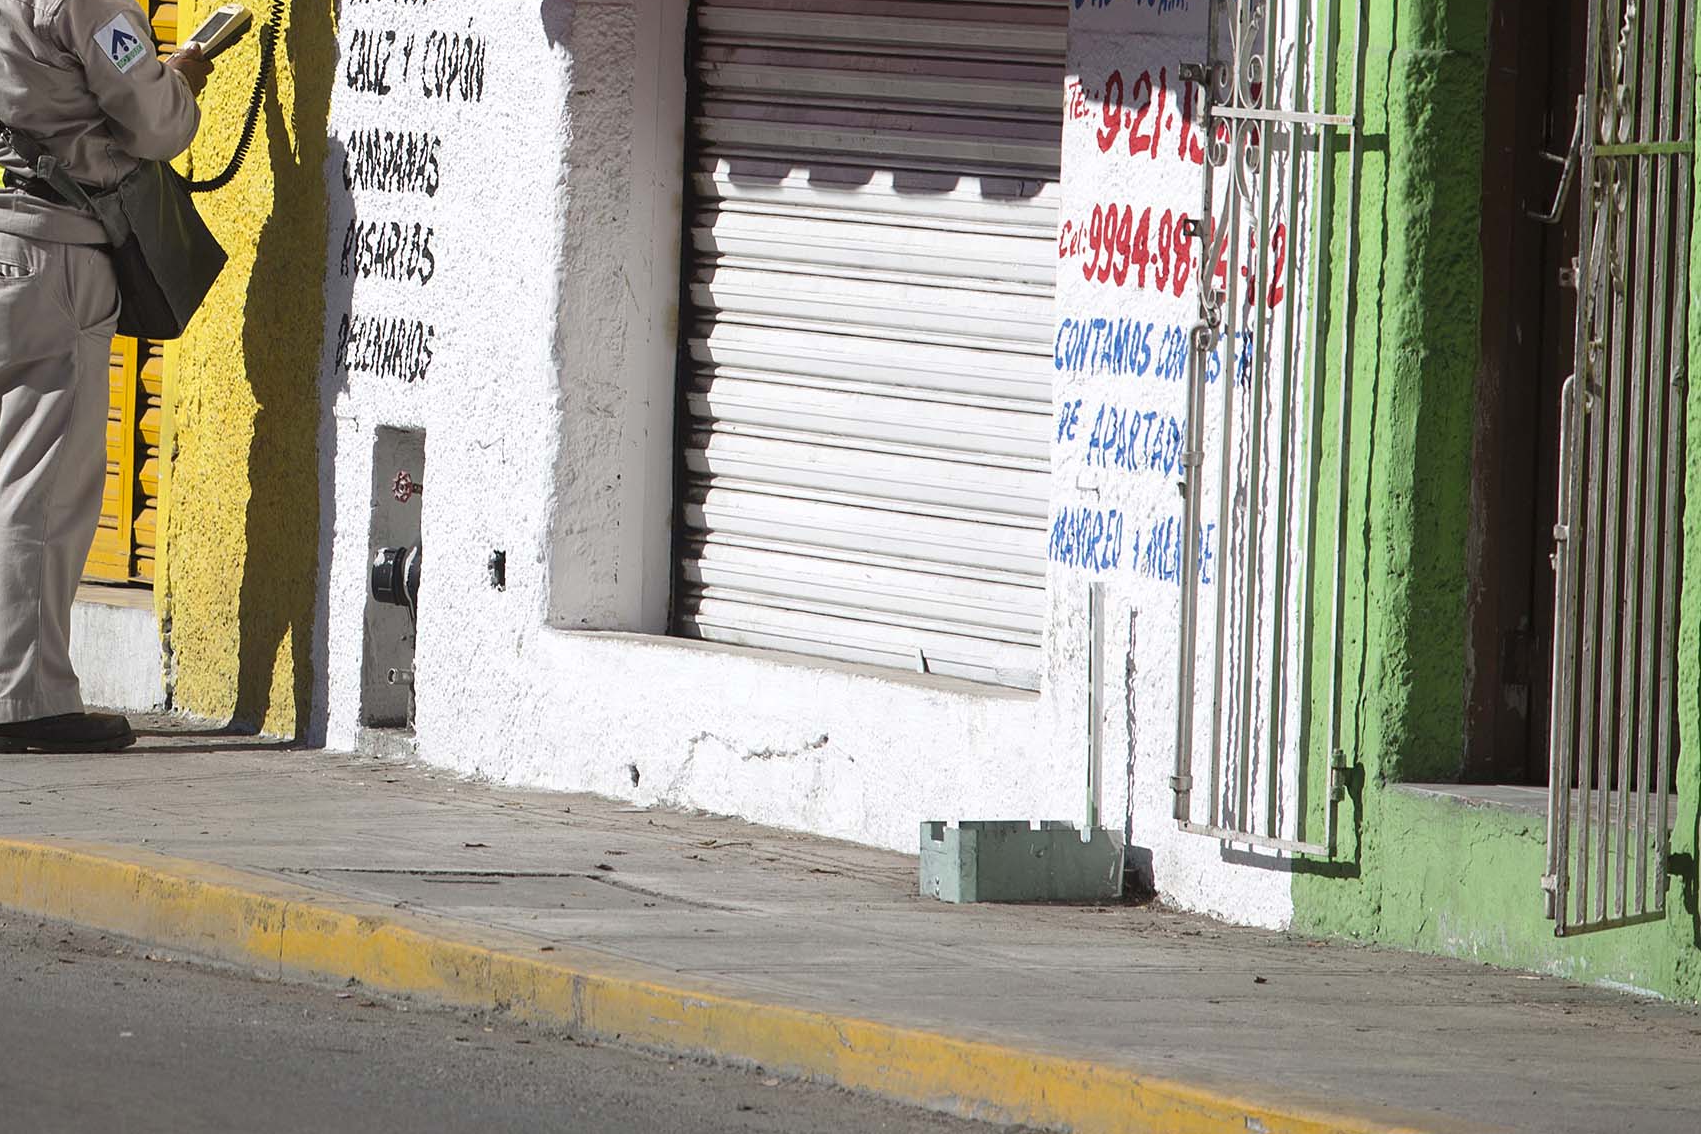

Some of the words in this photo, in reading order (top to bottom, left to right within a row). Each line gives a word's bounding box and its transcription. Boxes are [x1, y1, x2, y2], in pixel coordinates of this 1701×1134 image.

[403, 33, 414, 83] Y
[340, 219, 435, 286] ROSARIOS
[1054, 317, 1154, 377] CONTAMOS
[1049, 506, 1123, 574] MAYOREO
